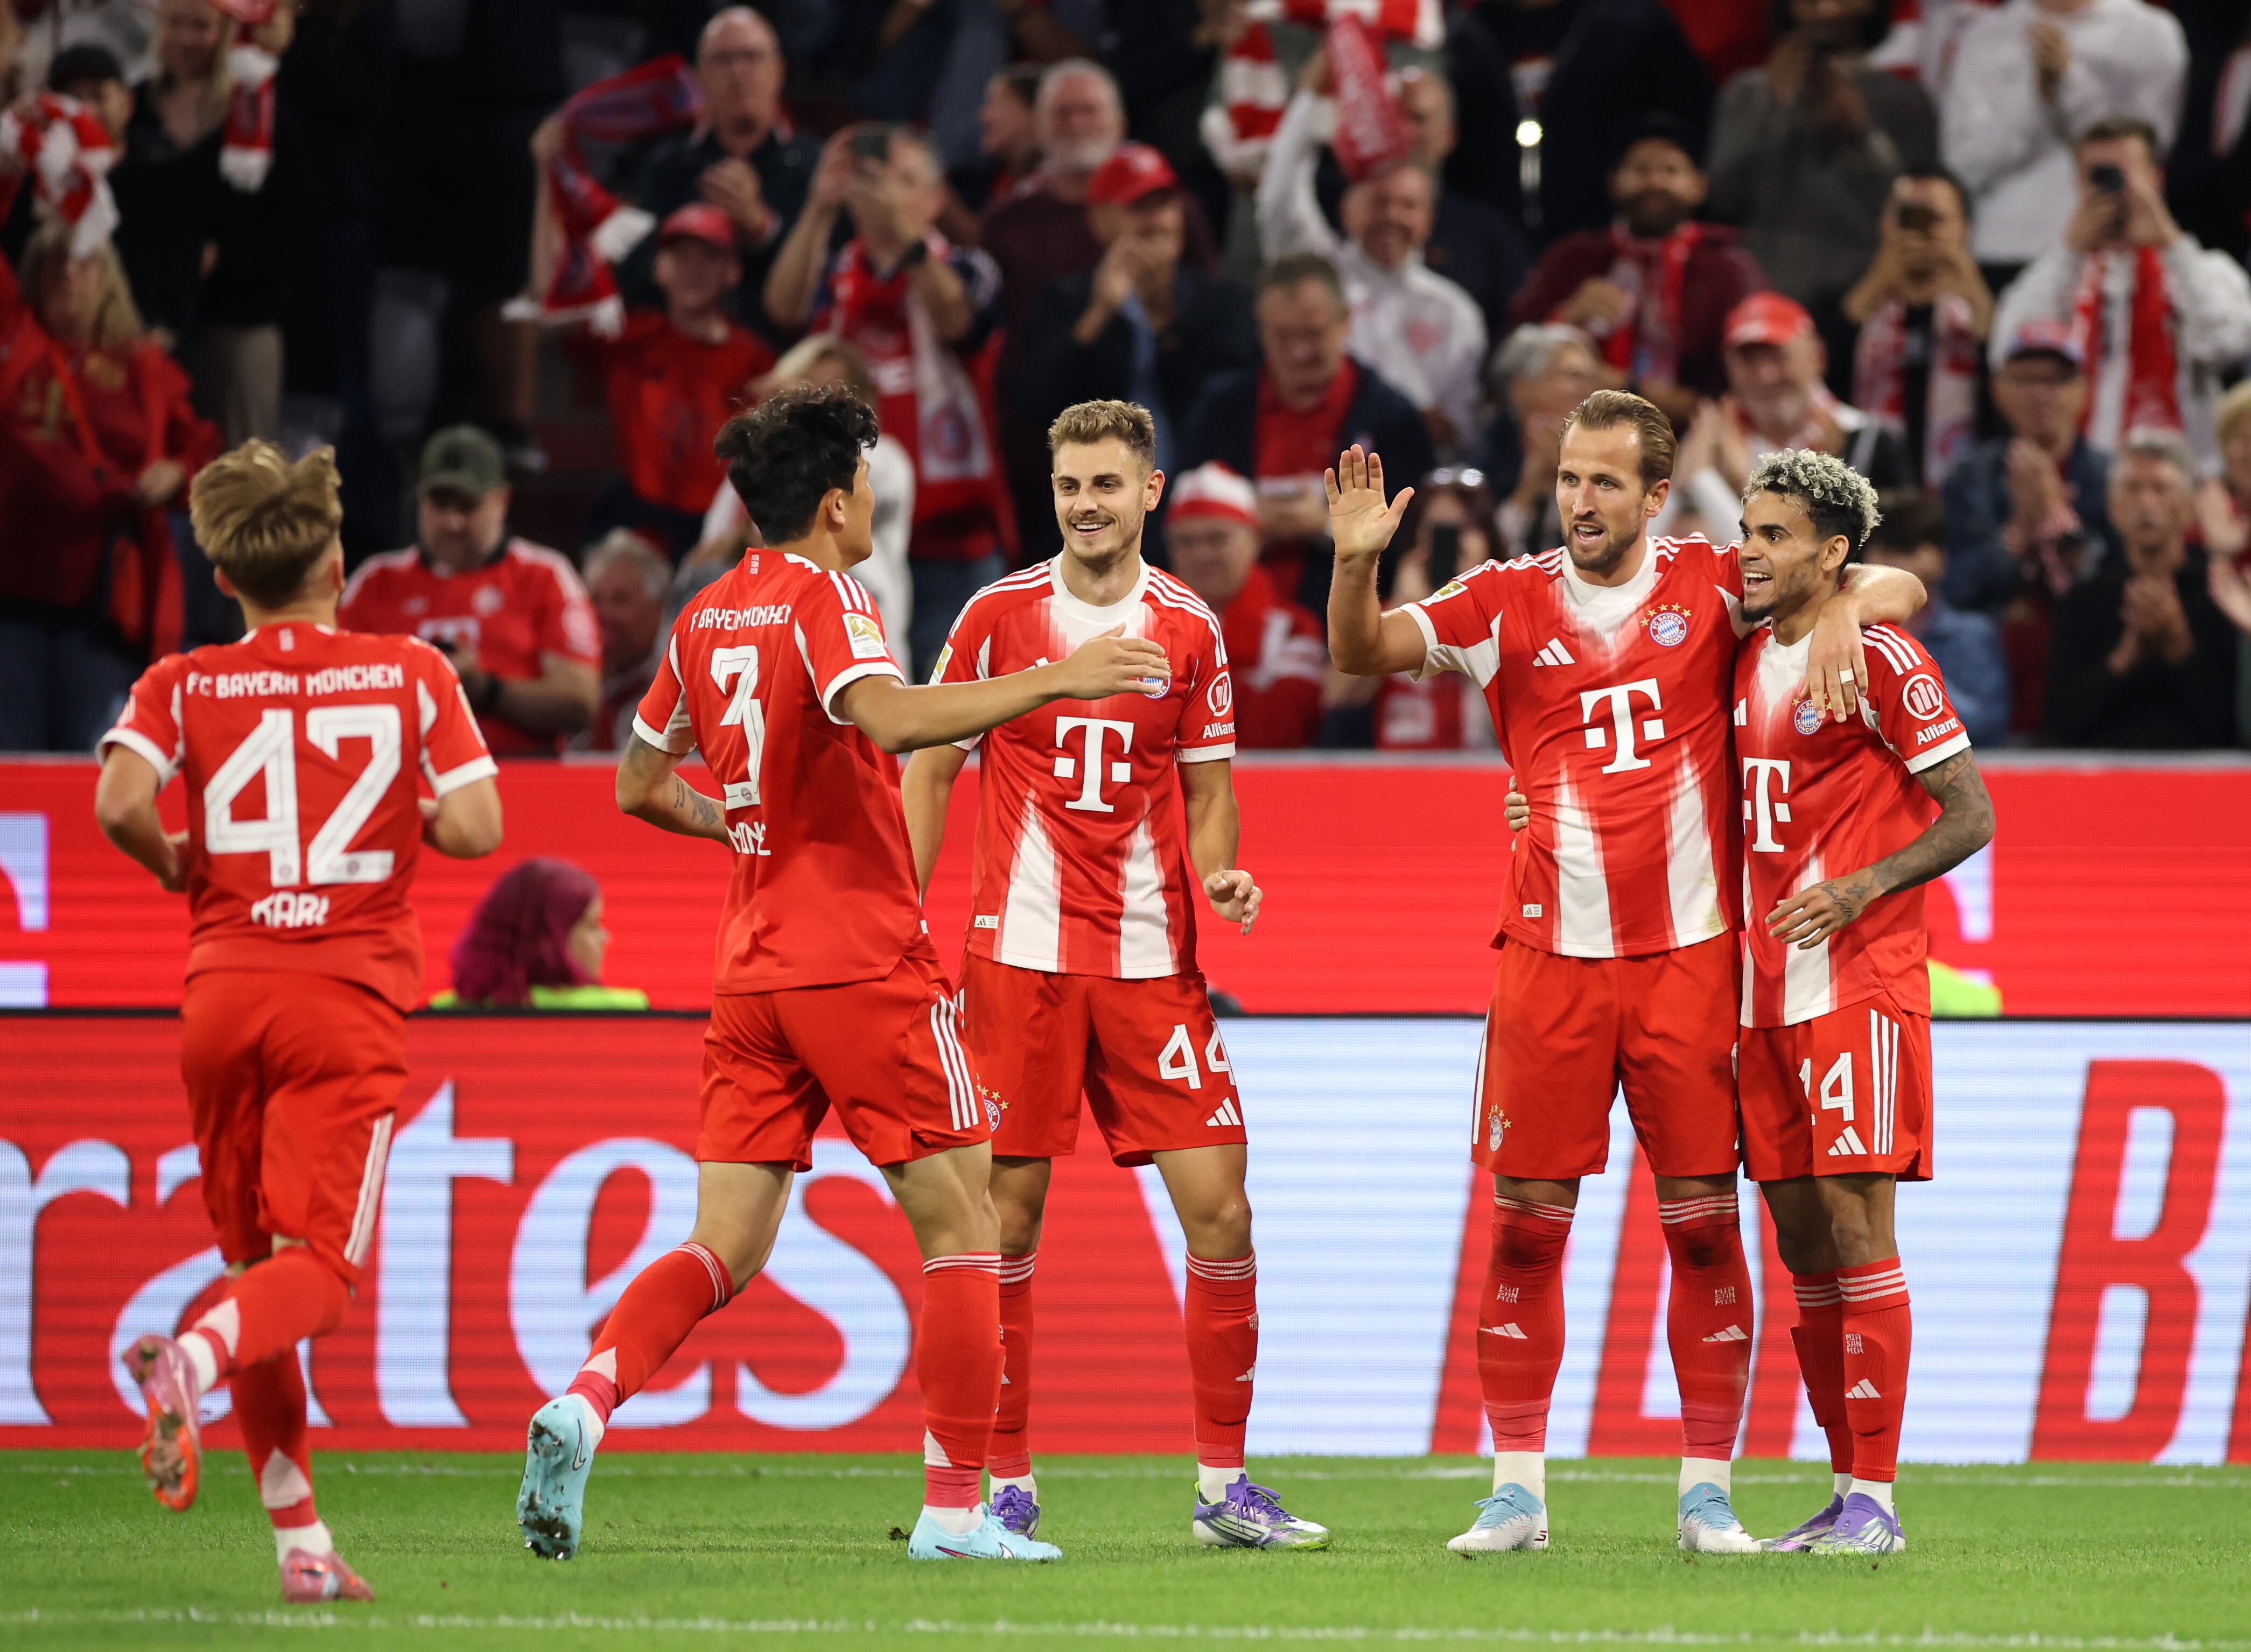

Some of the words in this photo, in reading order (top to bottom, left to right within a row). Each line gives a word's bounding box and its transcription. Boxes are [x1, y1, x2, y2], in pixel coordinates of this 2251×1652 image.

[1652, 621, 1659, 629] FC
[1658, 615, 1682, 625] BAYERN
[186, 671, 213, 697] FC
[216, 670, 299, 699] BAYERN
[1580, 678, 1665, 774] T
[1916, 717, 1959, 746] Allianz
[204, 704, 401, 887] 42
[1054, 716, 1134, 812] T
[1743, 757, 1792, 853] T
[1158, 1021, 1236, 1089] 44
[1798, 1051, 1855, 1126] 14
